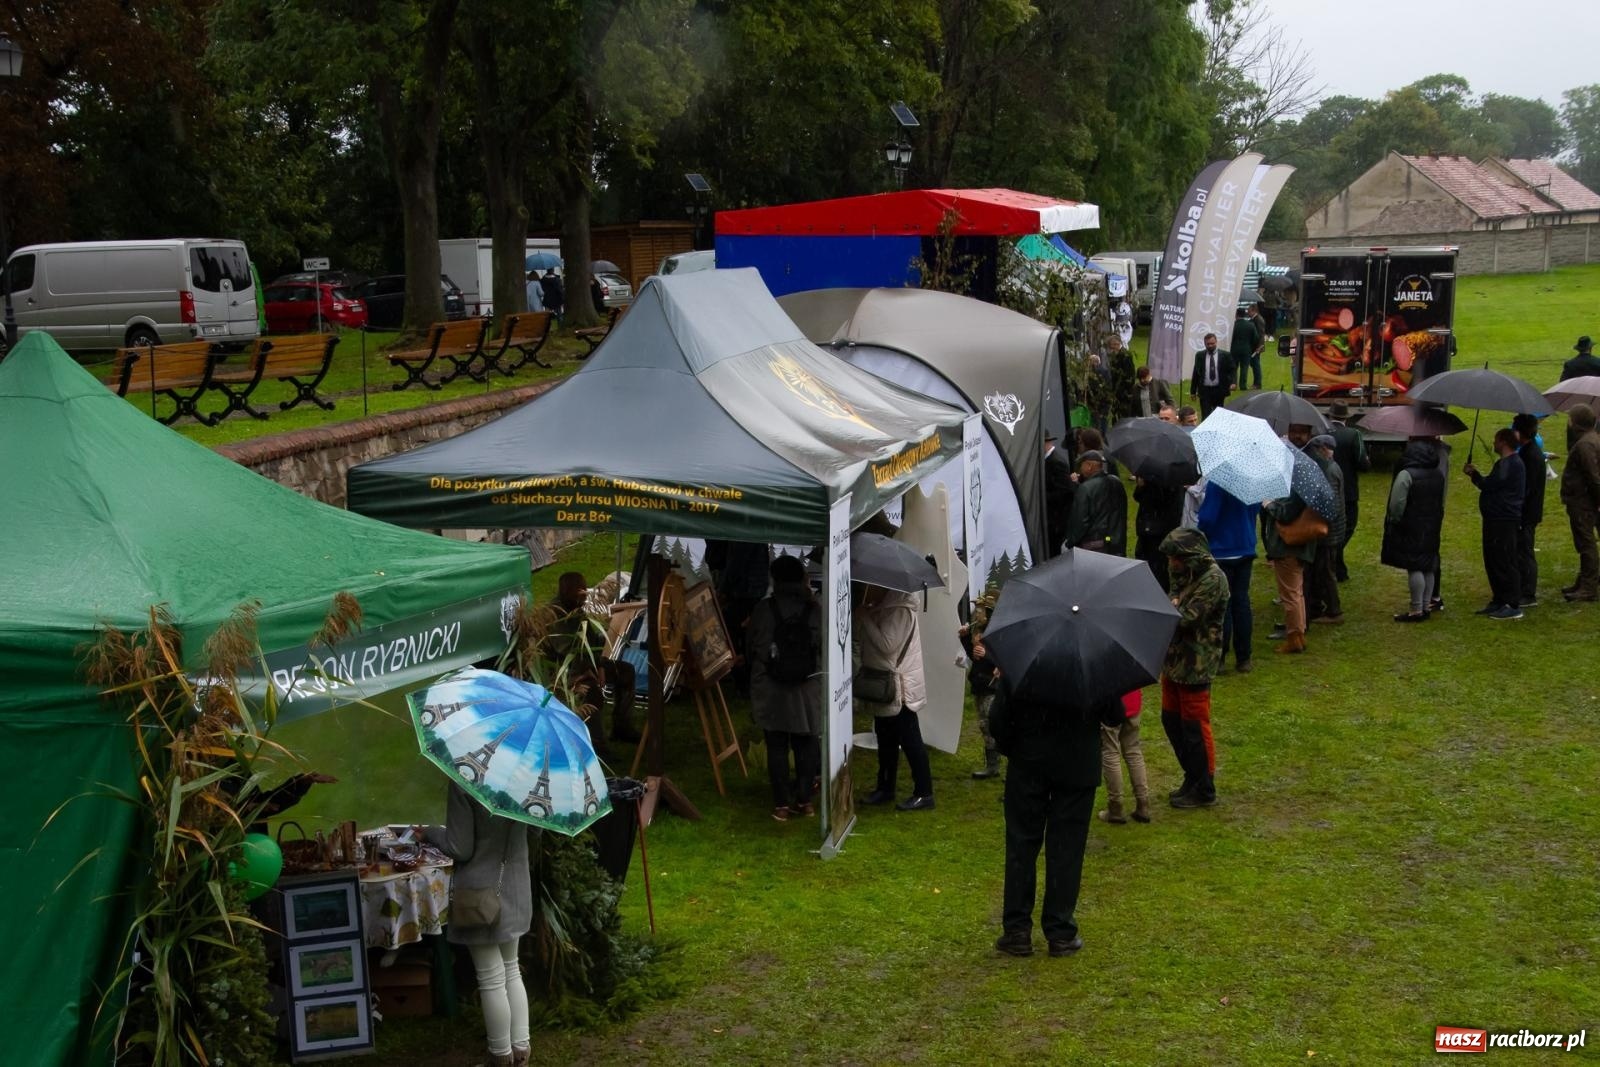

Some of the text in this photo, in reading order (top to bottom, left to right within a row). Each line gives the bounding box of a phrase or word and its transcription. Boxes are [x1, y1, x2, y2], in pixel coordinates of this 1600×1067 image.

[1171, 187, 1209, 272] kolba.pl
[1199, 181, 1239, 314] CHEVALIER
[1218, 190, 1267, 309] CHEVALIER
[305, 260, 319, 269] WC
[1393, 291, 1434, 301] JANETA
[430, 477, 451, 489] Dla
[454, 478, 506, 492] pożytku
[580, 477, 588, 487] a
[590, 475, 610, 488] św.
[613, 478, 682, 497] Hubertowi
[684, 487, 696, 497] w
[698, 486, 743, 500] chwale
[492, 493, 508, 505] od
[511, 492, 573, 506] Słuchaczy
[576, 492, 611, 506] kursu
[614, 495, 668, 511] WIOSNA
[688, 501, 720, 513] 2017
[556, 509, 613, 523] Darz Bór
[362, 621, 461, 681] RYBNICKI
